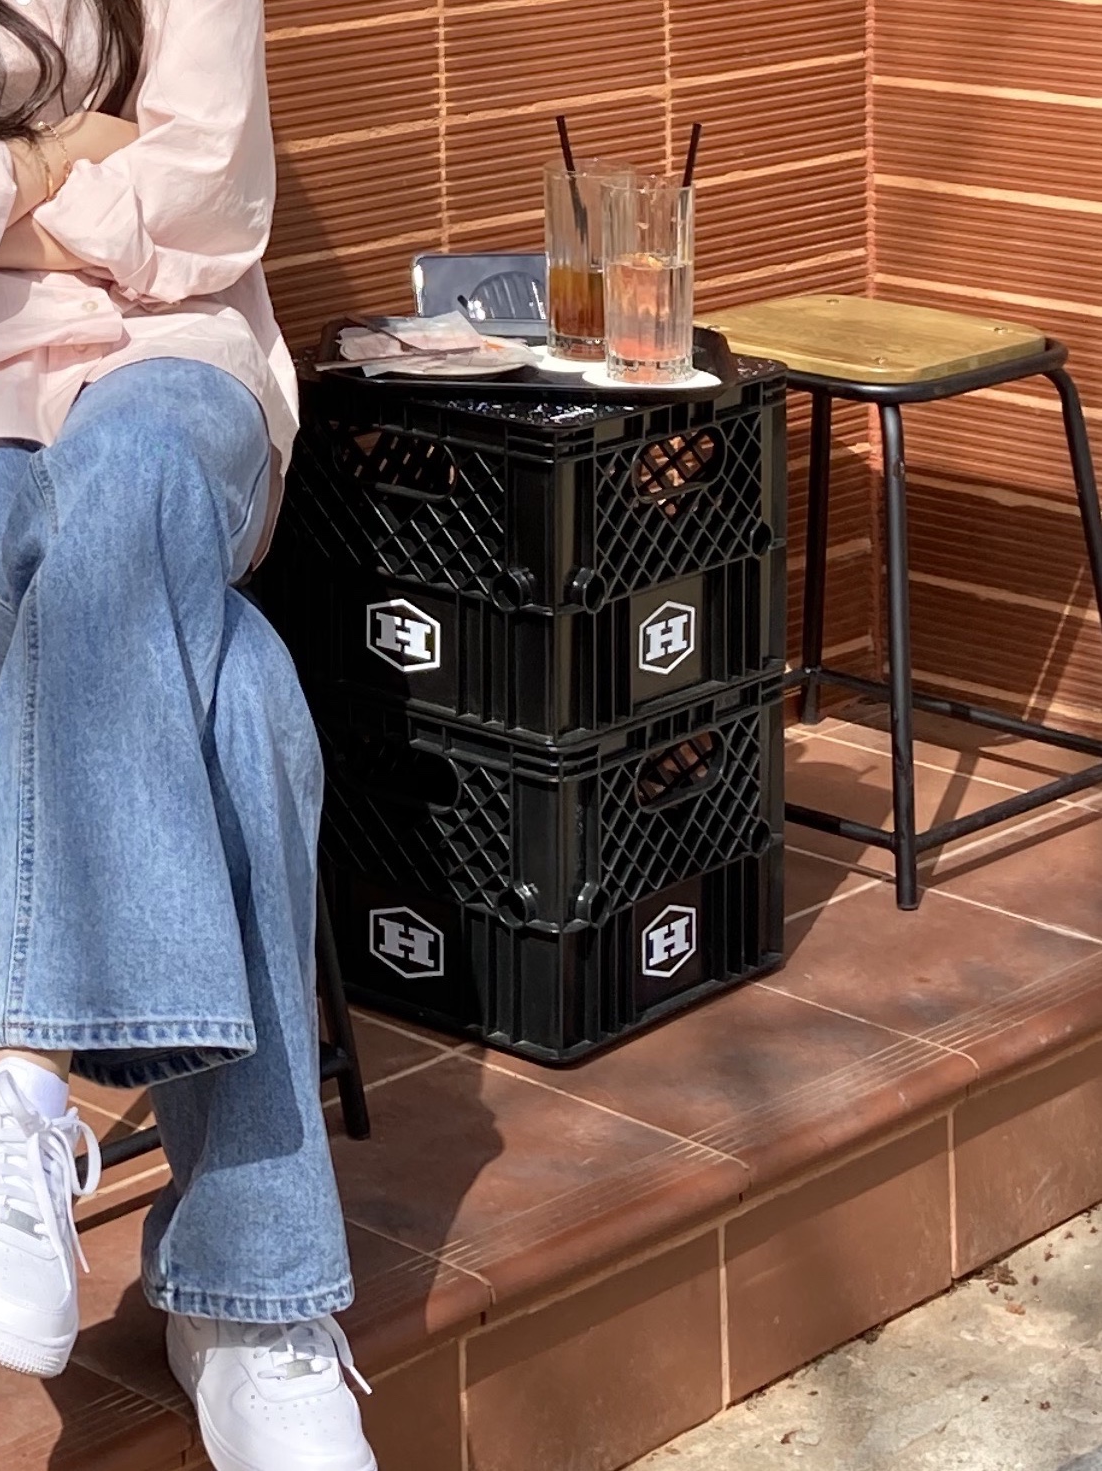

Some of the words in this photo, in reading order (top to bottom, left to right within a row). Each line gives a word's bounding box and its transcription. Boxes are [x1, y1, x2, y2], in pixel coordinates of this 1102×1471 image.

[376, 611, 432, 661] H
[645, 613, 689, 662] H
[379, 917, 434, 967] H
[648, 915, 690, 967] H
